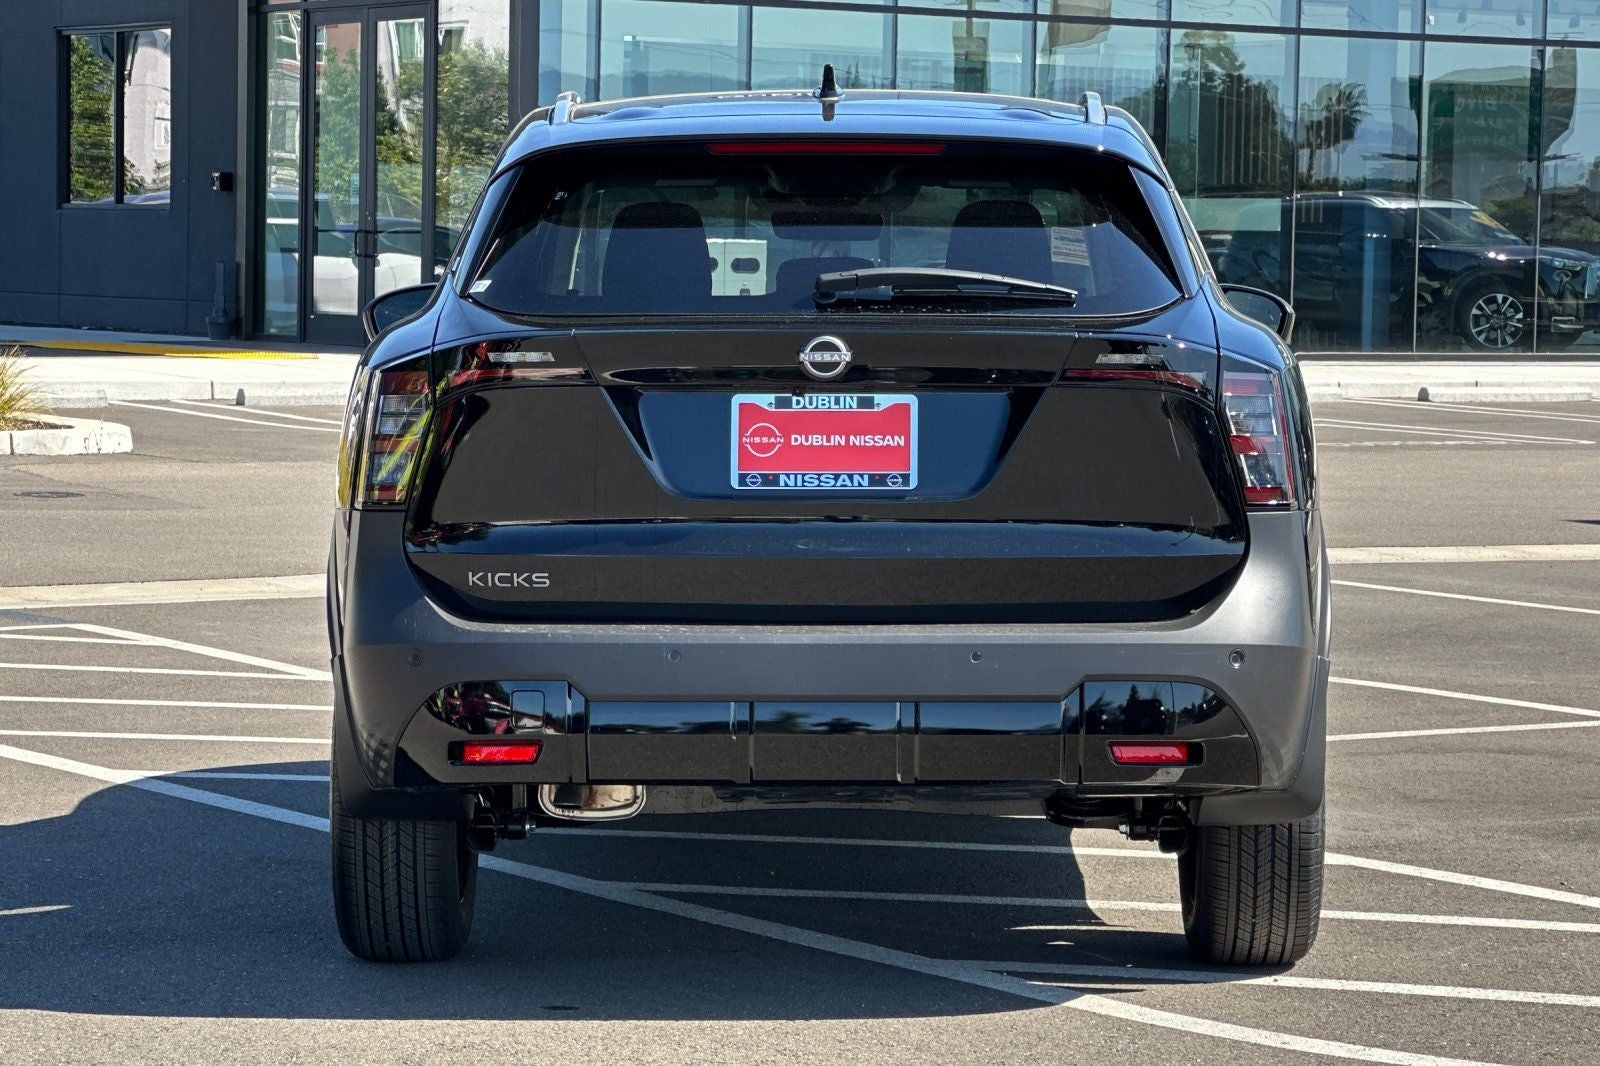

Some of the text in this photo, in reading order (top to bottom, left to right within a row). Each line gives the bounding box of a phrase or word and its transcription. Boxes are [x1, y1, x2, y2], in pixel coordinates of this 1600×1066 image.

[800, 353, 849, 361] NISSAN
[792, 395, 857, 409] DUBLIN
[791, 434, 905, 447] DUBLIN NISSAN
[779, 474, 868, 487] NISSAN
[468, 571, 550, 588] KICKS
